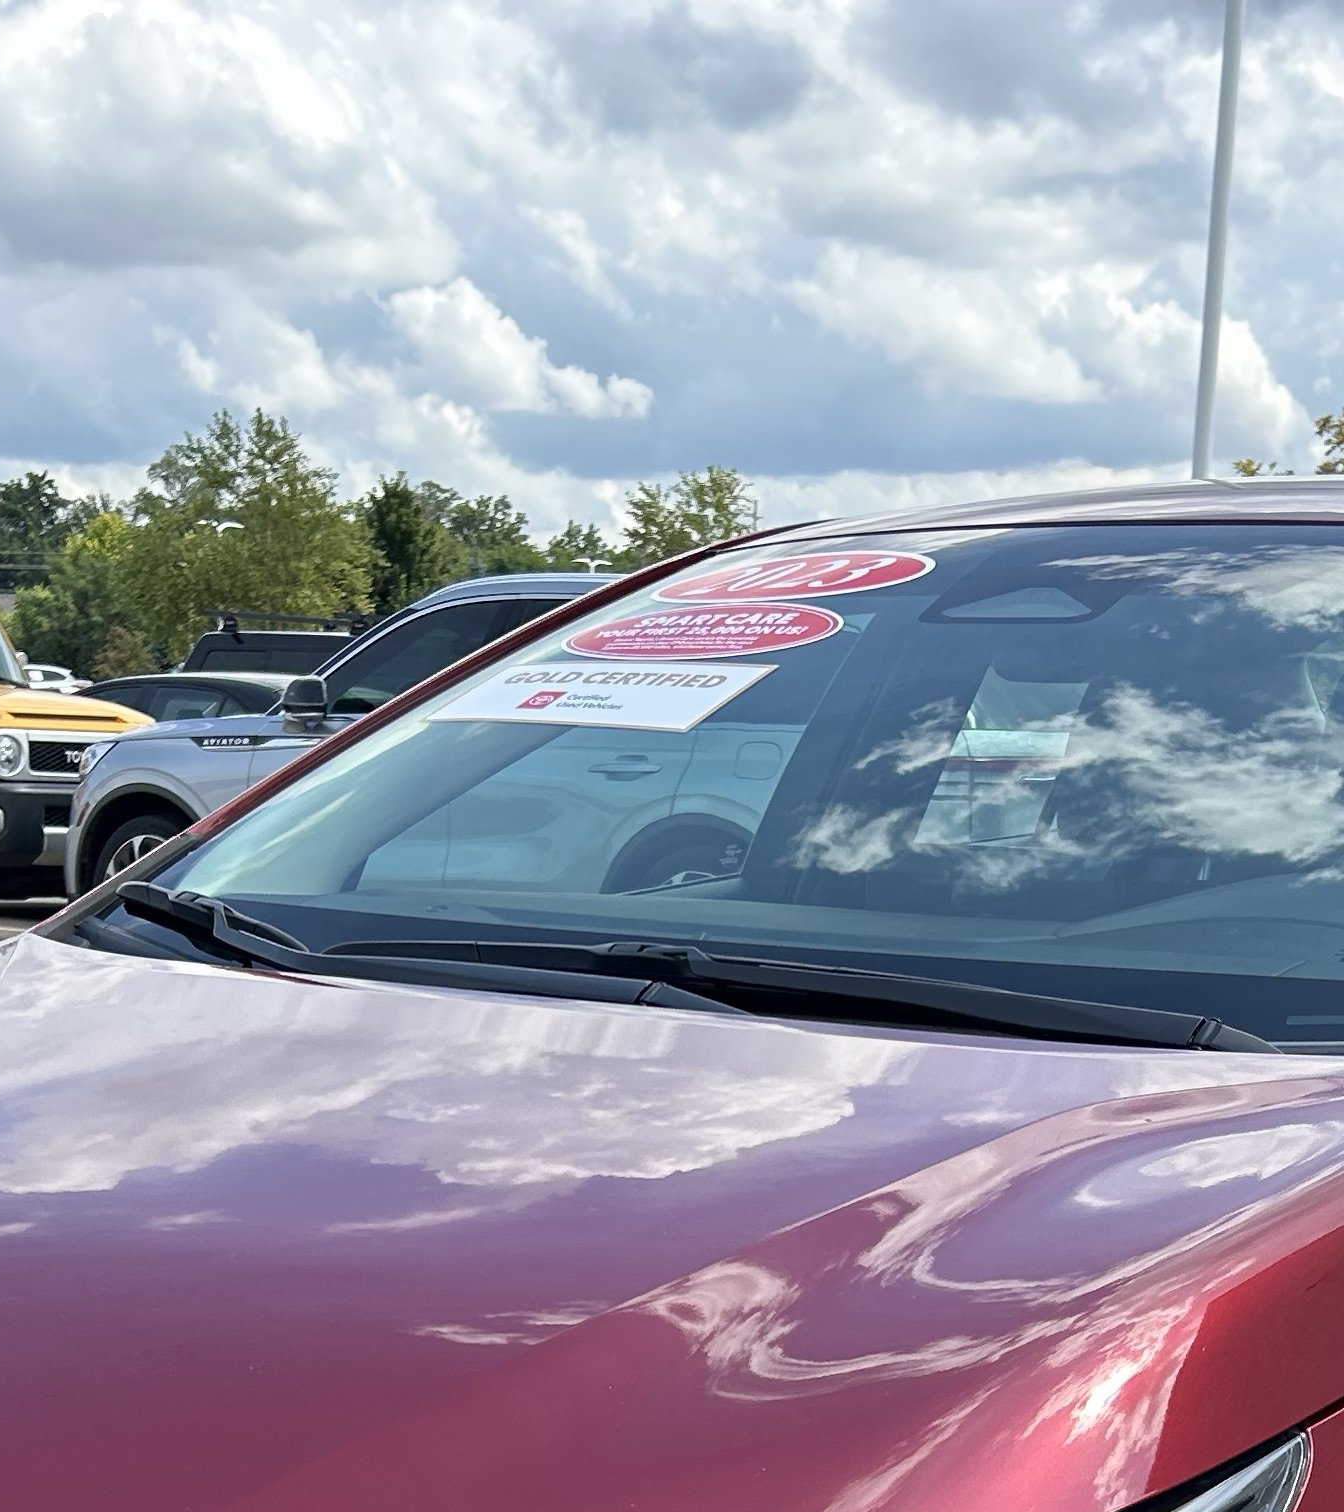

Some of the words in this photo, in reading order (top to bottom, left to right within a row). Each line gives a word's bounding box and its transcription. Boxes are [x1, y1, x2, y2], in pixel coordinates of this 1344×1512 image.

[677, 557, 898, 597] 2023
[634, 613, 724, 627] SMART
[724, 612, 802, 626] CARE
[595, 628, 641, 638] YOUR
[640, 626, 690, 637] FIRST
[744, 625, 775, 635] ON
[775, 625, 810, 636] US!
[503, 671, 583, 685] GOLD
[581, 672, 729, 689] CERTIFIED
[202, 737, 250, 746] AVIATOR
